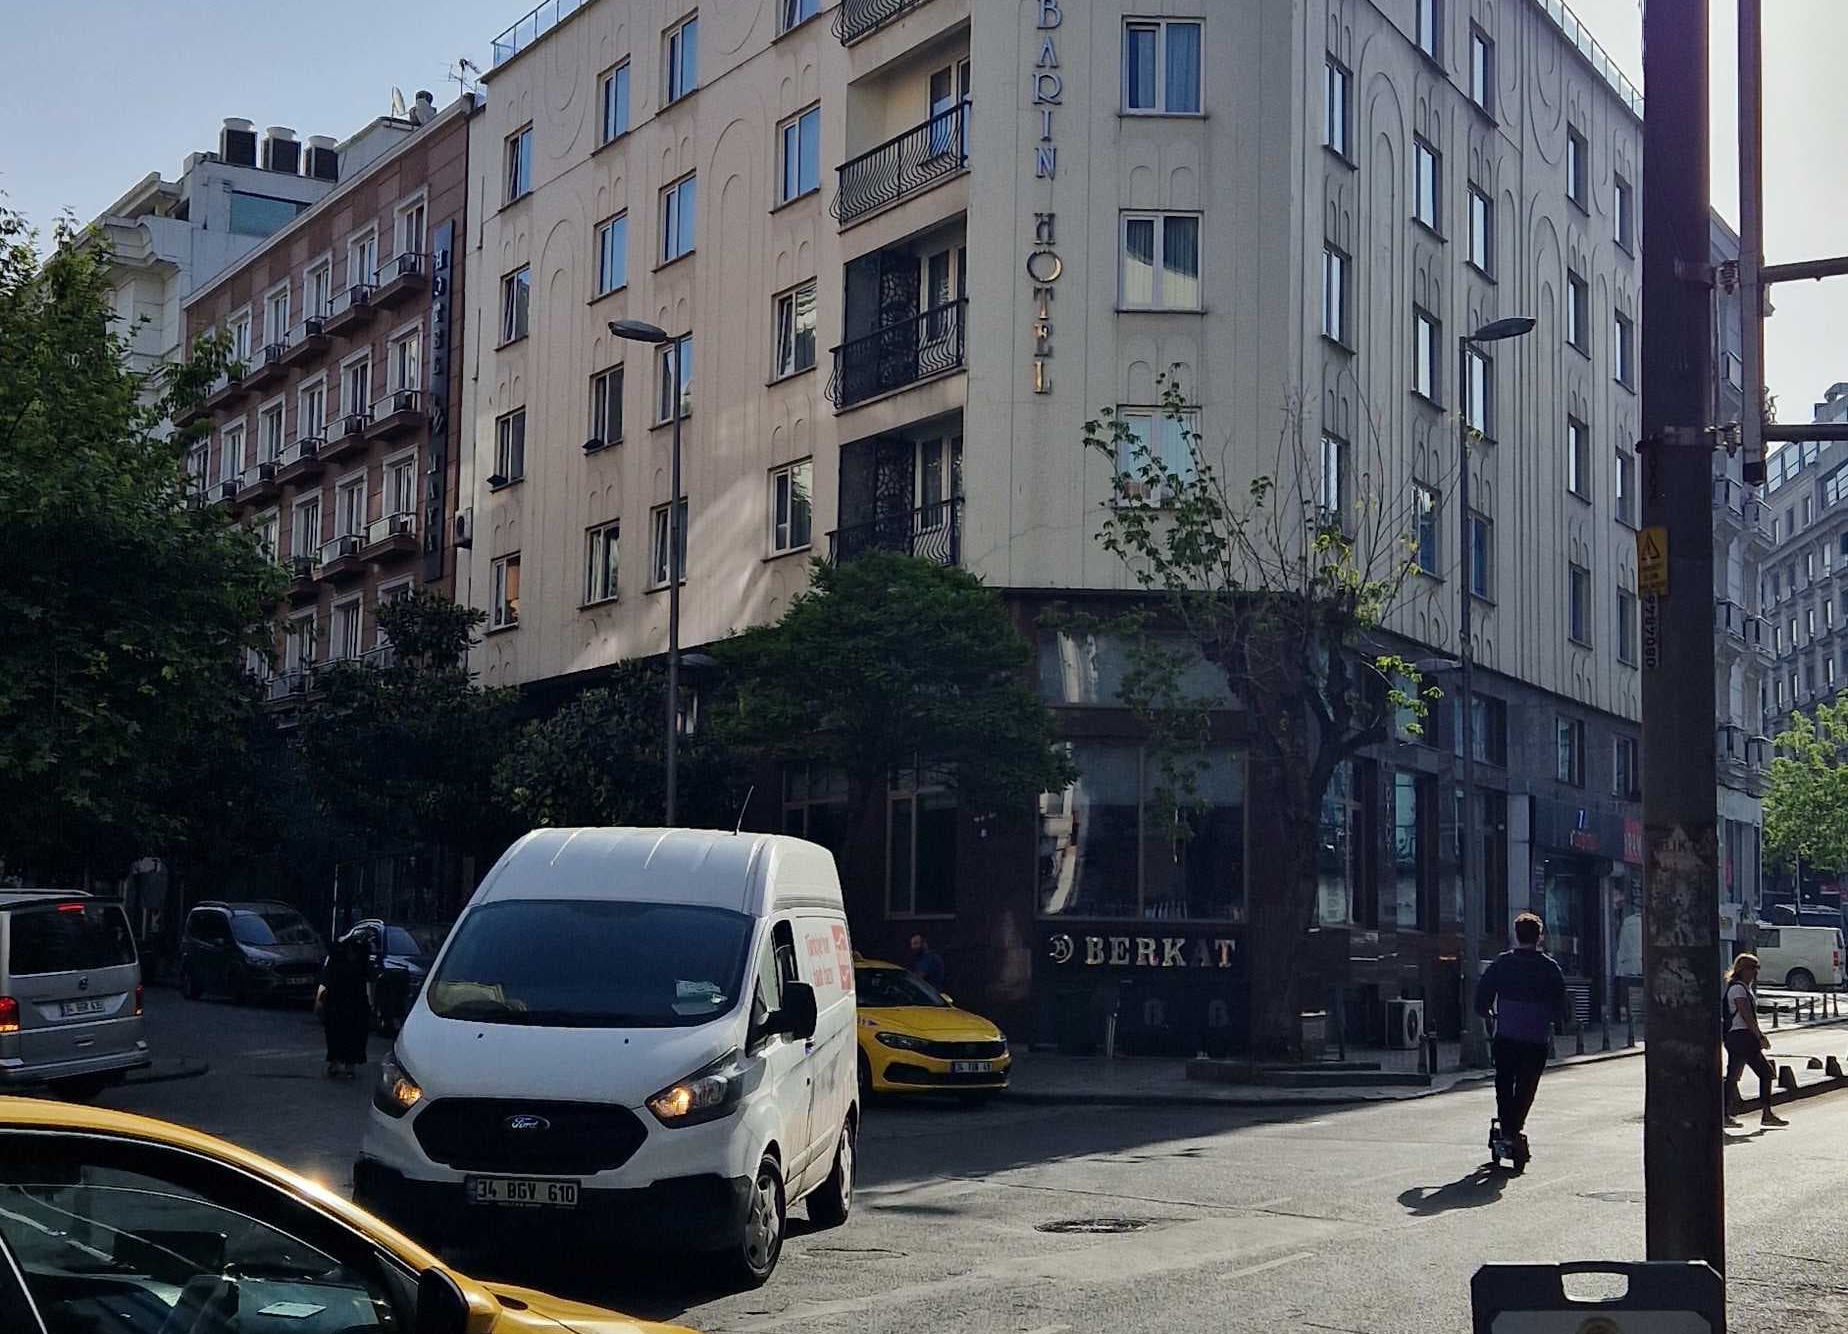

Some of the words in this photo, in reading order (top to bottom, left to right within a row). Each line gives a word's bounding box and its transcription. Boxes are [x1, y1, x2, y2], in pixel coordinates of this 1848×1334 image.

[1027, 212, 1063, 395] HOTEL
[1085, 935, 1236, 968] BERKAT
[478, 1180, 497, 1198] 34
[506, 1182, 537, 1201] BGV
[547, 1184, 576, 1203] 610
